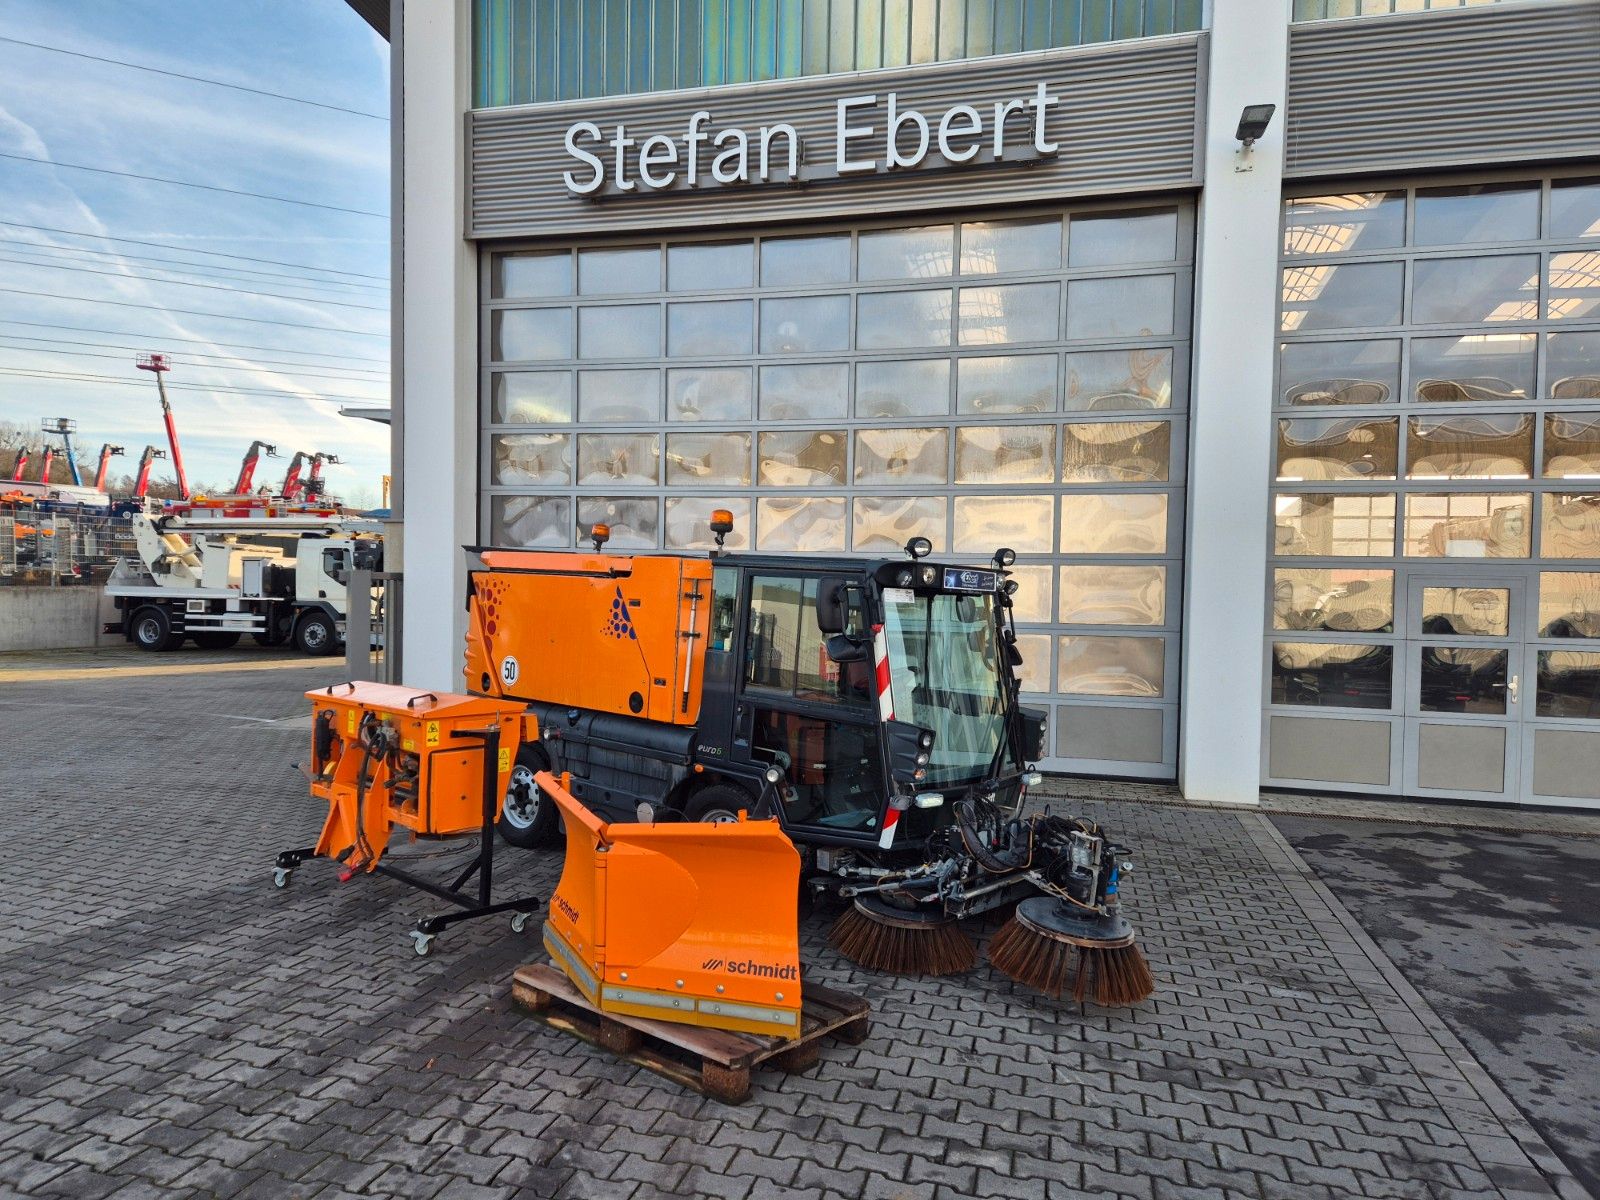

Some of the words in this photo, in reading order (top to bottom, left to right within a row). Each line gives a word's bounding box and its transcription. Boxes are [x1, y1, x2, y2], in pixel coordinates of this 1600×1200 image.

[563, 111, 798, 195] Stefan
[837, 82, 1059, 174] Ebert
[504, 660, 516, 681] 50
[727, 959, 797, 981] schmidt
